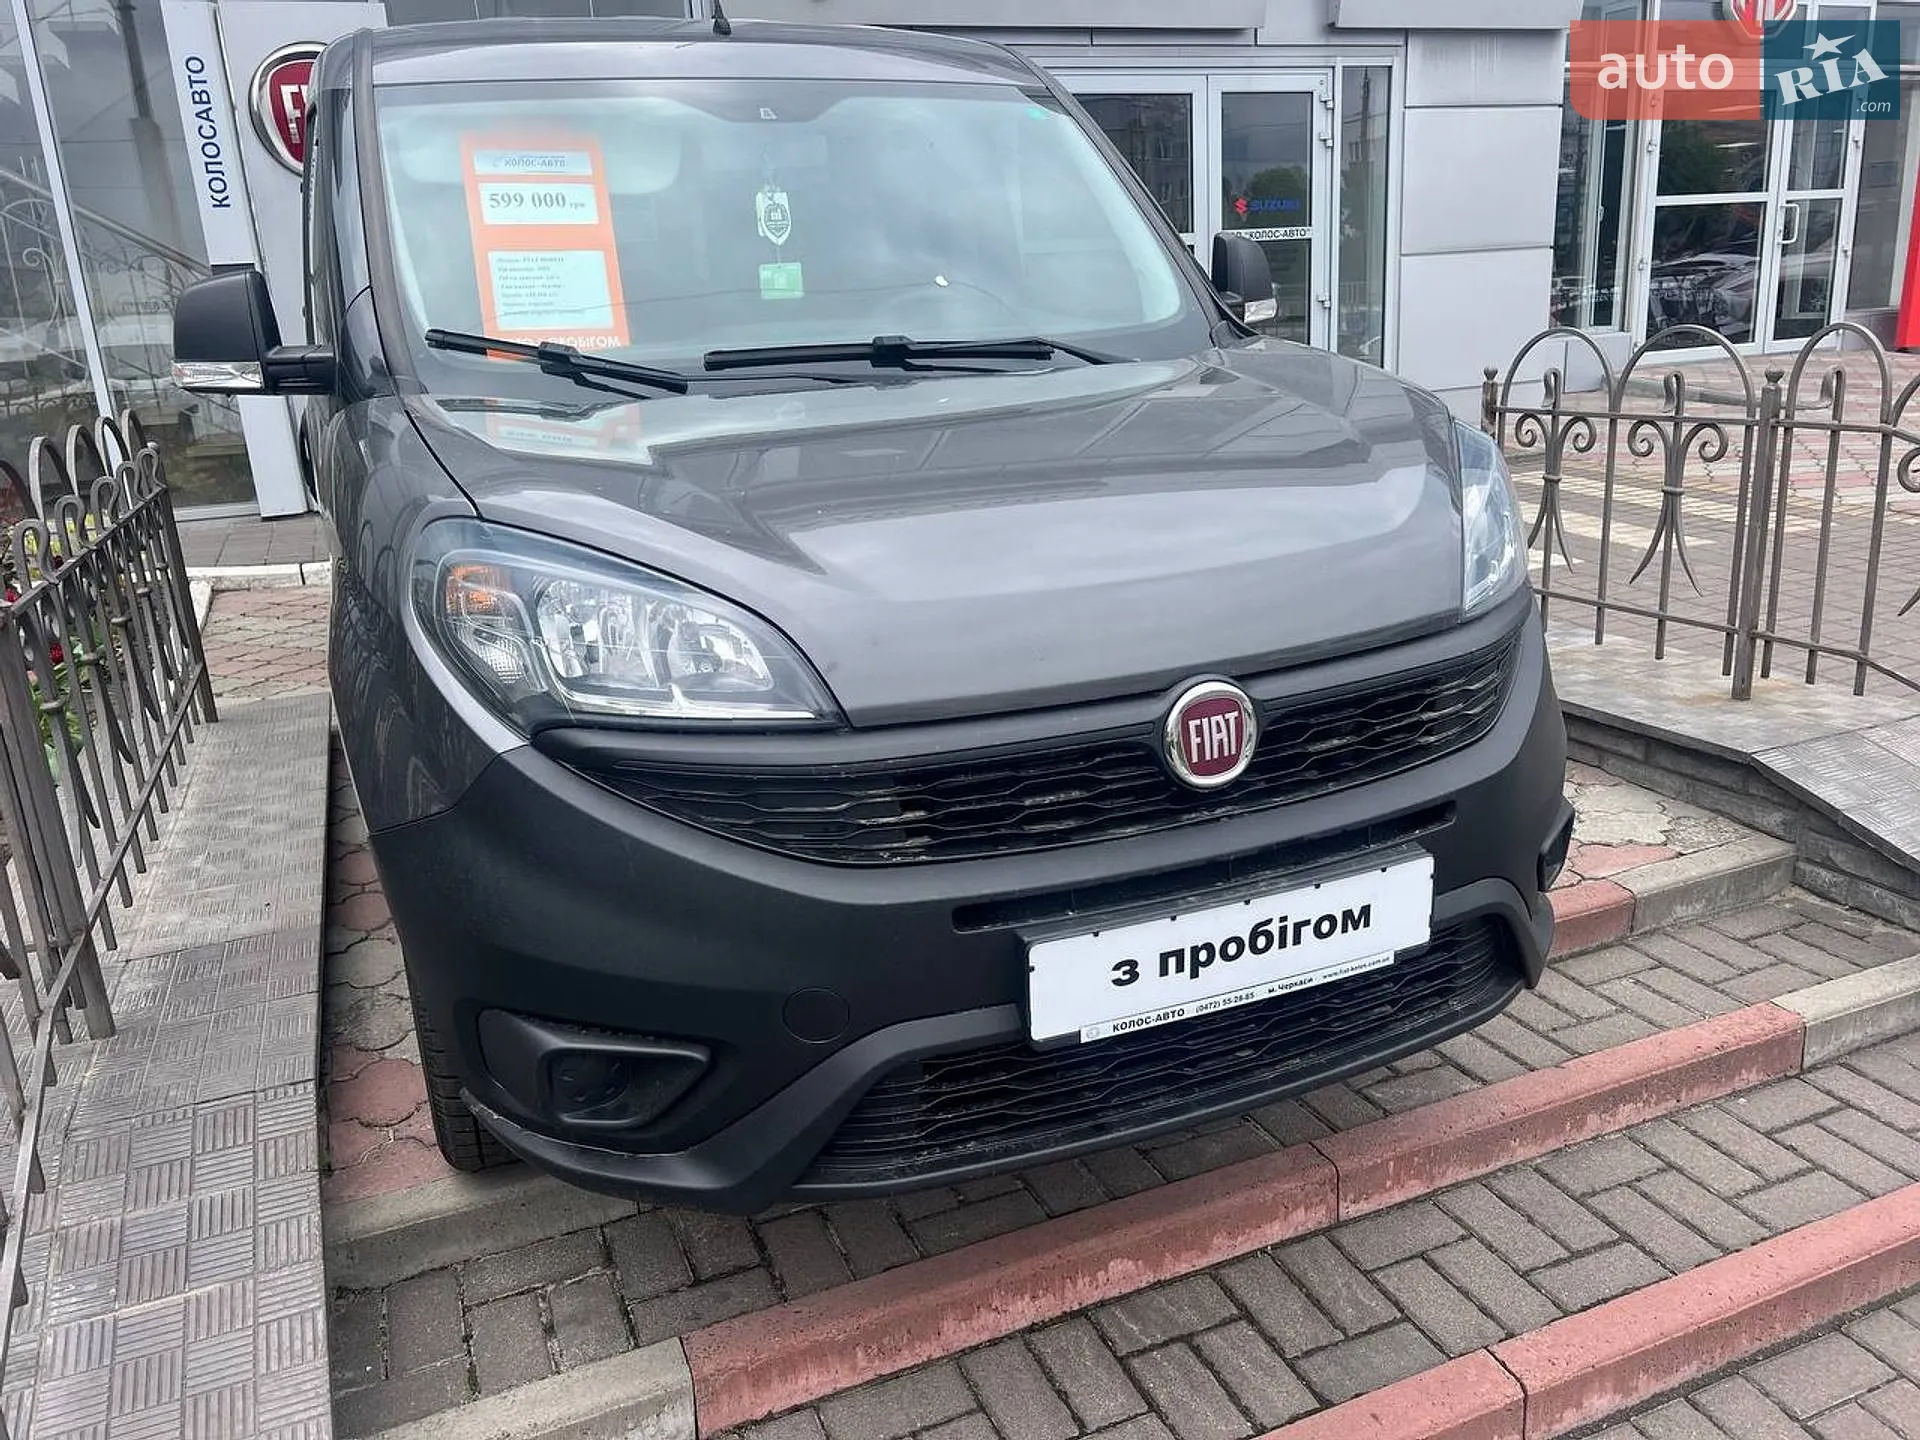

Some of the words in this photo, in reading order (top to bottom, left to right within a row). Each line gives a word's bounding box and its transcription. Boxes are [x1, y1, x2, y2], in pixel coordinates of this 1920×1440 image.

[185, 56, 231, 209] КОЛОСАВТО
[488, 192, 524, 209] 599
[531, 192, 567, 208] 000
[1188, 710, 1239, 764] FIAT
[1111, 958, 1140, 987] з
[1159, 903, 1372, 979] пробігом
[1112, 1008, 1185, 1033] КОЛОС-АВТО
